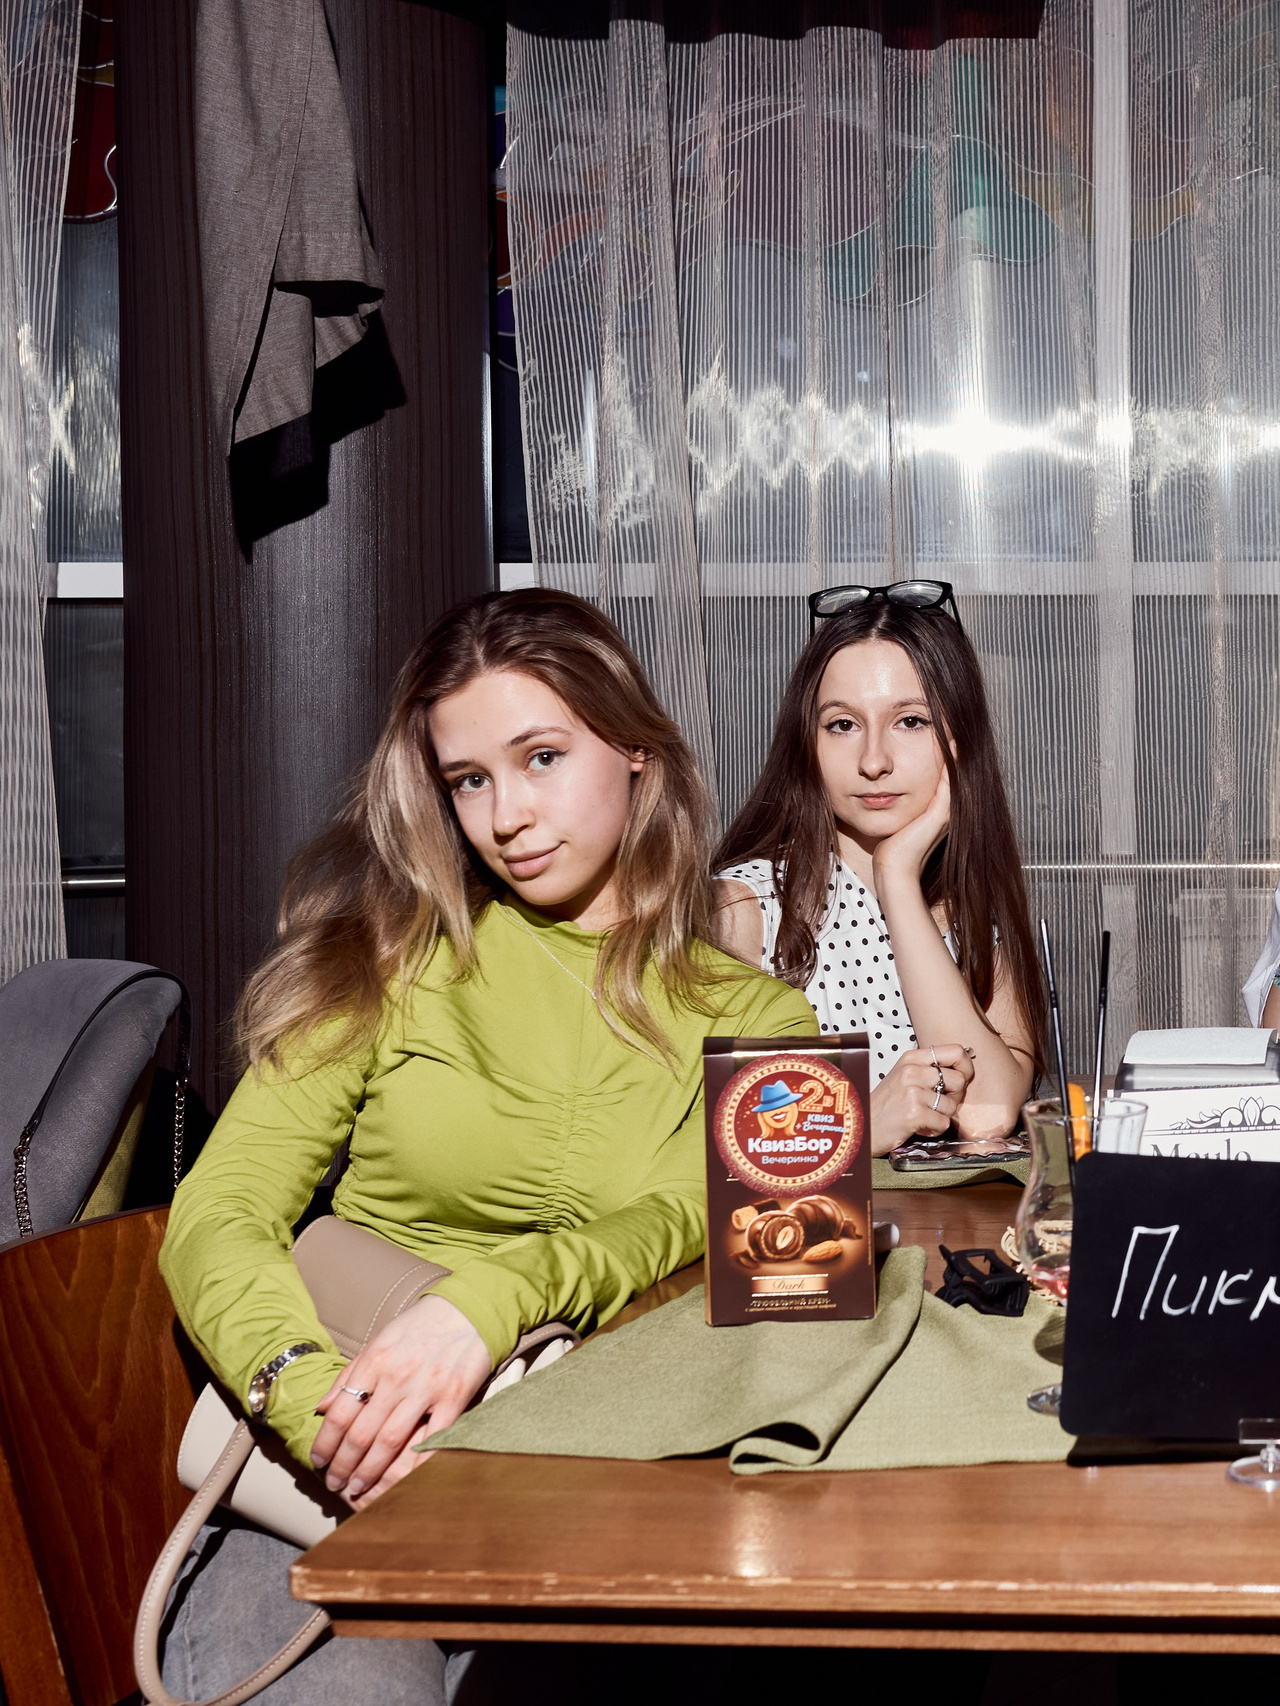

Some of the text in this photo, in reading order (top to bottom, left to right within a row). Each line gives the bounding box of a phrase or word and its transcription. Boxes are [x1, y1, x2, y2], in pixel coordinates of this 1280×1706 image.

[747, 1136, 833, 1154] КвизБор
[761, 1155, 819, 1165] Вечеринка
[773, 1279, 806, 1290] Dark
